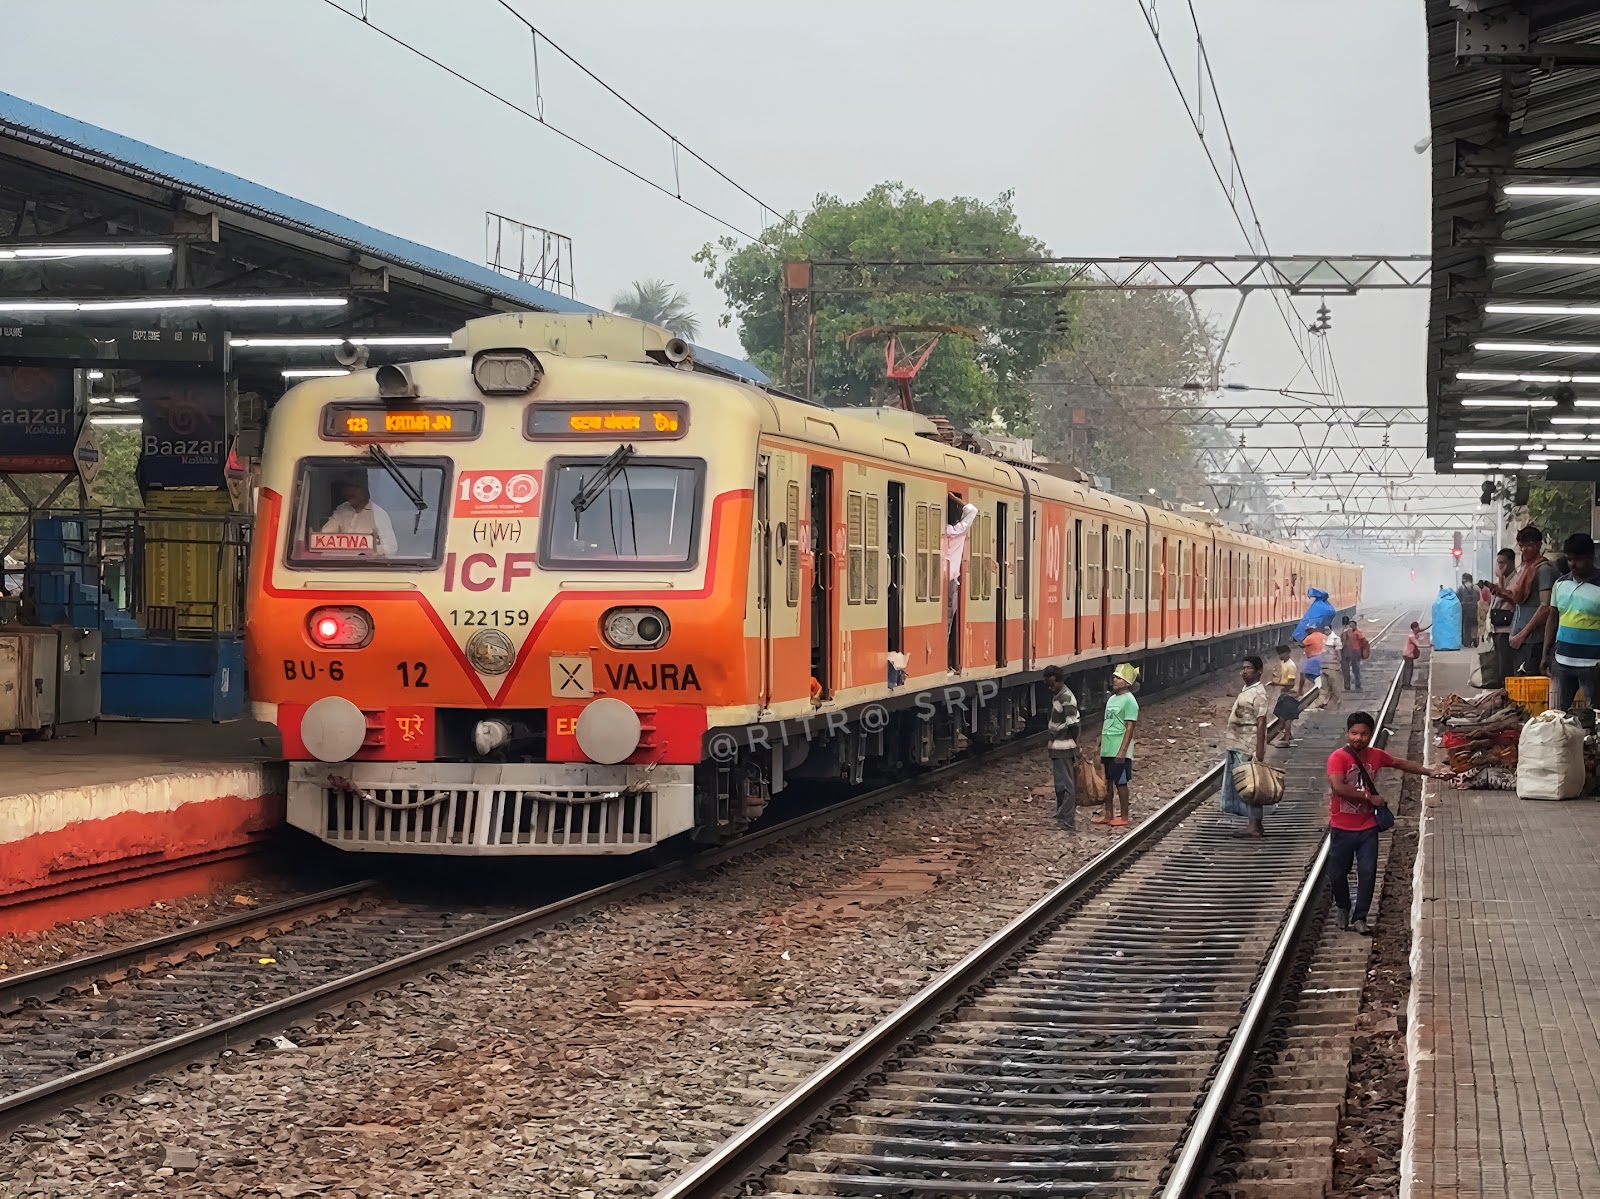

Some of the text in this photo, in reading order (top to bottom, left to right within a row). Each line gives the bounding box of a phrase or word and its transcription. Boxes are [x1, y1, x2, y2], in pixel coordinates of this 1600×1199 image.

[1, 408, 71, 424] aazar
[386, 415, 430, 431] KATWA
[432, 415, 451, 430] JN
[144, 435, 222, 456] Baazar
[315, 535, 369, 548] KATWA
[443, 552, 537, 593] ICF
[450, 609, 529, 626] 122159
[283, 660, 345, 681] BU-6
[397, 661, 429, 688] 12
[604, 663, 702, 691] VAJRA
[395, 714, 425, 742] पूरे
